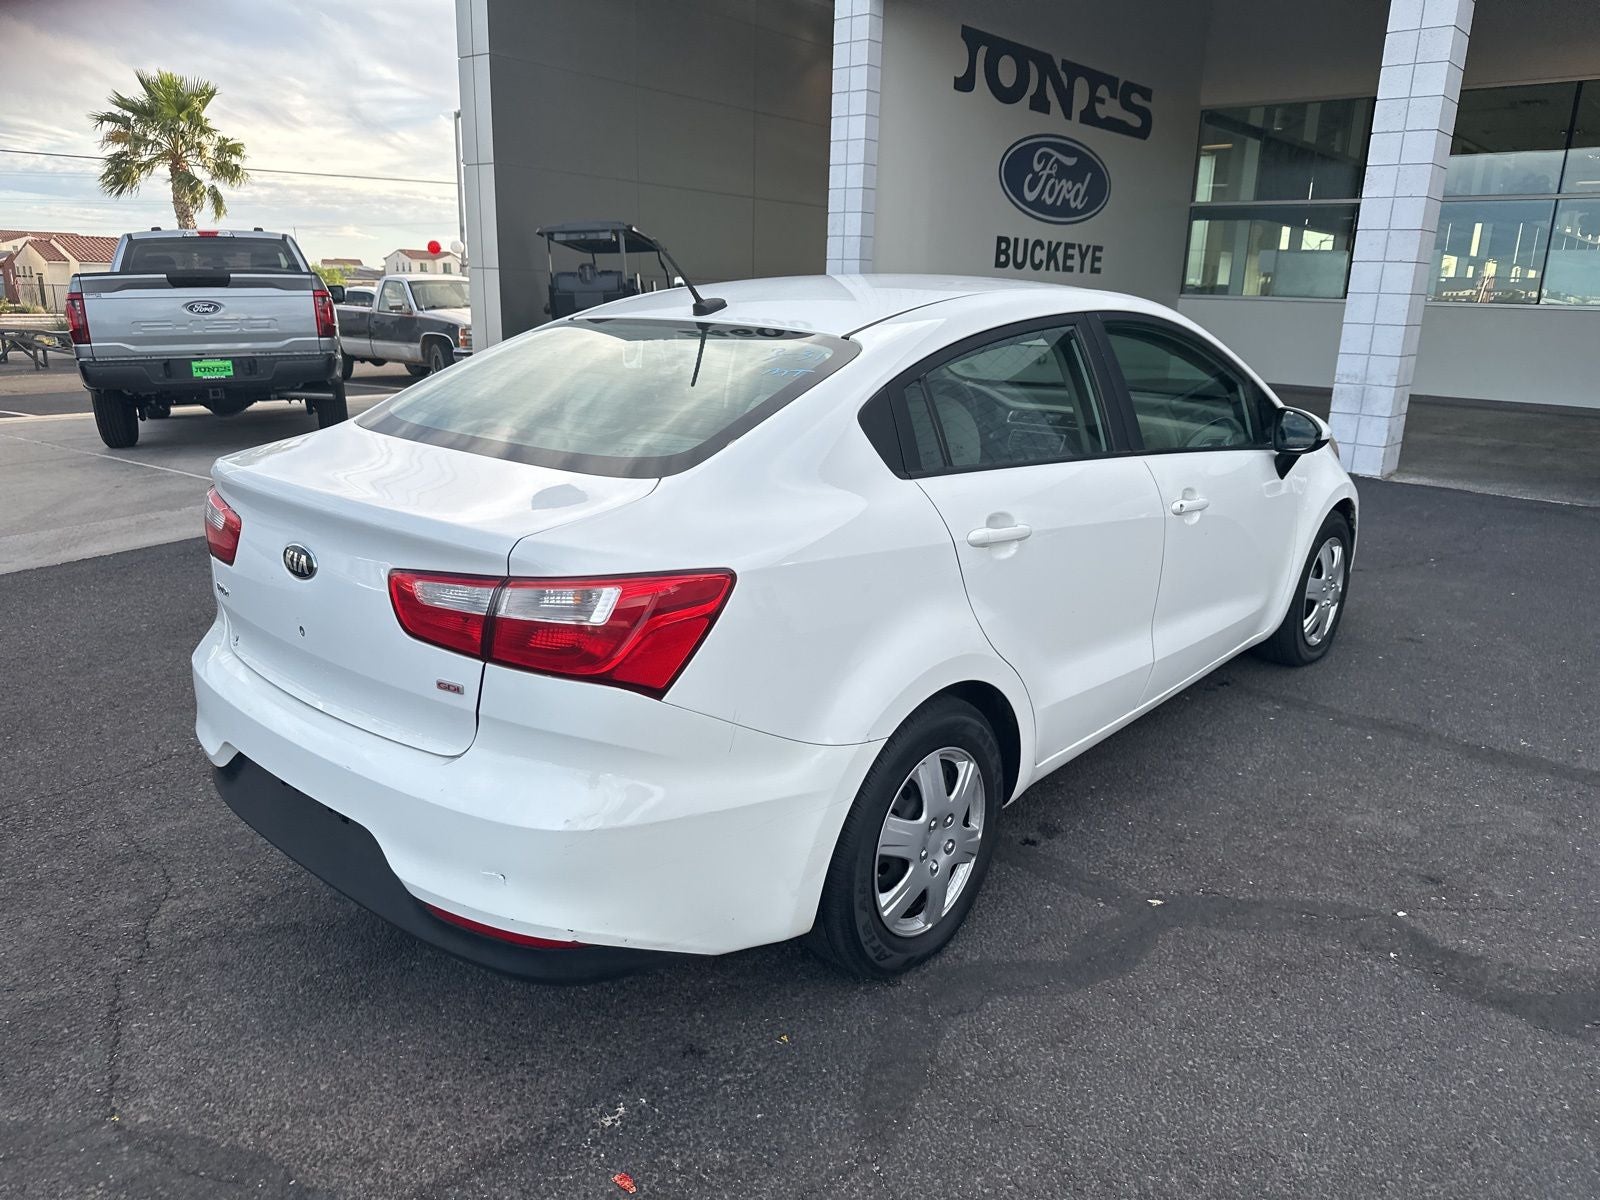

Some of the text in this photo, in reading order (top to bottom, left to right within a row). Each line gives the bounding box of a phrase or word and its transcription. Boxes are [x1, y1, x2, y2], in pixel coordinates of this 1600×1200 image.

[953, 24, 1153, 141] JONES
[1023, 147, 1093, 210] Ford
[994, 235, 1104, 274] BUCKEYE
[193, 365, 232, 374] JONES
[284, 548, 310, 575] KIA
[437, 681, 461, 694] GDI
